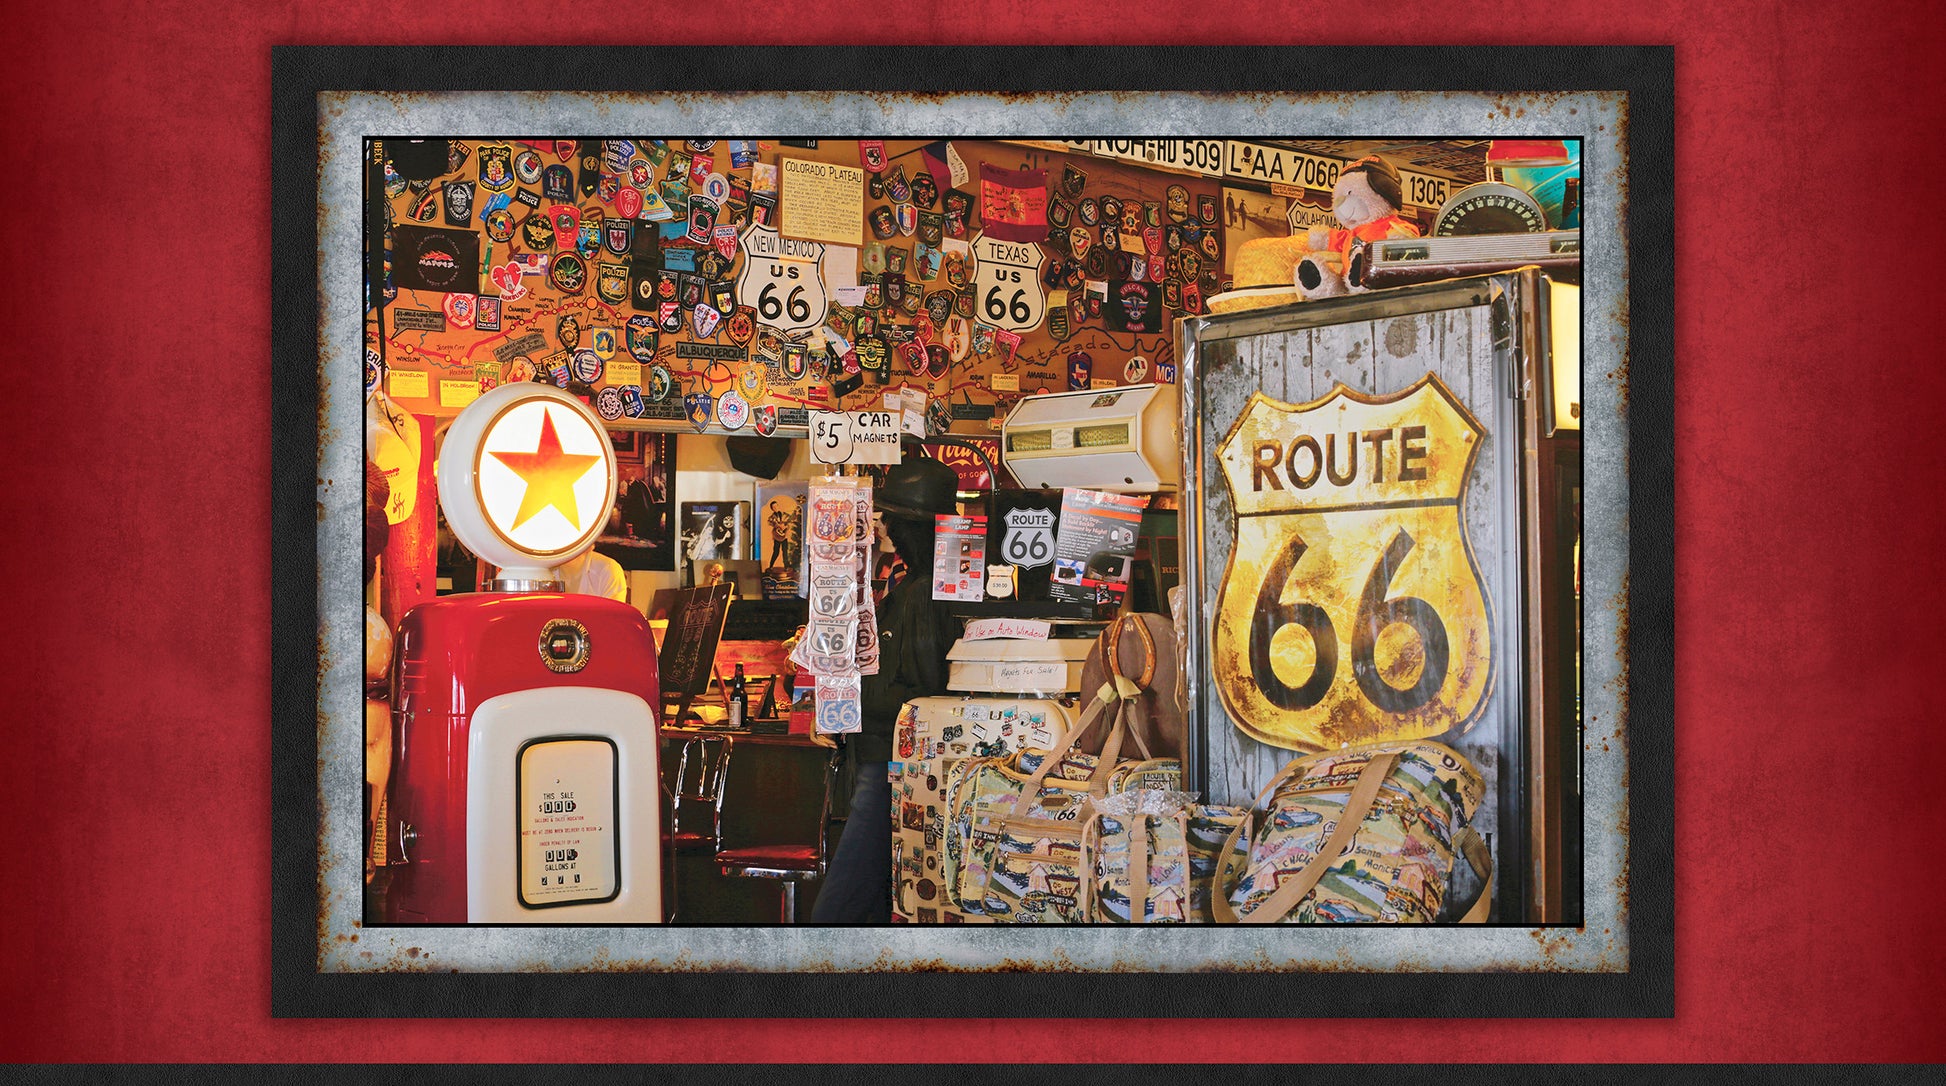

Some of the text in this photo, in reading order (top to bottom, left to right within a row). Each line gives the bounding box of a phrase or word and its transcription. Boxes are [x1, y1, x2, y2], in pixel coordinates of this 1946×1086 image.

[1183, 140, 1221, 171] 509
[1231, 144, 1242, 173] L
[1251, 149, 1285, 181] AA
[785, 161, 862, 183] COLORADO PLATEAU
[1409, 175, 1446, 207] 1305
[519, 194, 538, 206] POLICE
[606, 221, 630, 230] POLIZEI
[718, 237, 736, 246] CRS
[753, 235, 815, 259] NEW MEXICO
[988, 242, 1030, 264] TEXAS
[602, 267, 626, 276] POLIZEI
[770, 264, 800, 280] US
[995, 268, 1022, 284] US
[500, 287, 526, 301] HAMBURG
[757, 282, 811, 323] 66
[984, 285, 1032, 324] 66
[678, 343, 748, 360] ALBUQUERQUE
[1026, 370, 1057, 380] AMARILLO
[1156, 365, 1174, 383] MCi
[853, 432, 899, 445] MAGNETS
[1251, 424, 1428, 492] ROUTE
[818, 512, 849, 537] 66
[1011, 513, 1049, 526] ROUTE
[1008, 530, 1049, 561] 66
[819, 579, 847, 587] ROUTE
[820, 595, 848, 613] 66
[1248, 525, 1450, 715] 66
[976, 625, 986, 637] Use
[997, 622, 1014, 636] Auto
[1015, 625, 1048, 640] Window
[816, 632, 845, 651] 66
[823, 702, 858, 727] 66
[560, 791, 574, 799] SALE
[1056, 808, 1077, 821] 66
[1354, 845, 1382, 859] Santa
[544, 862, 577, 872] GALLONS AT
[1056, 887, 1073, 896] WEST
